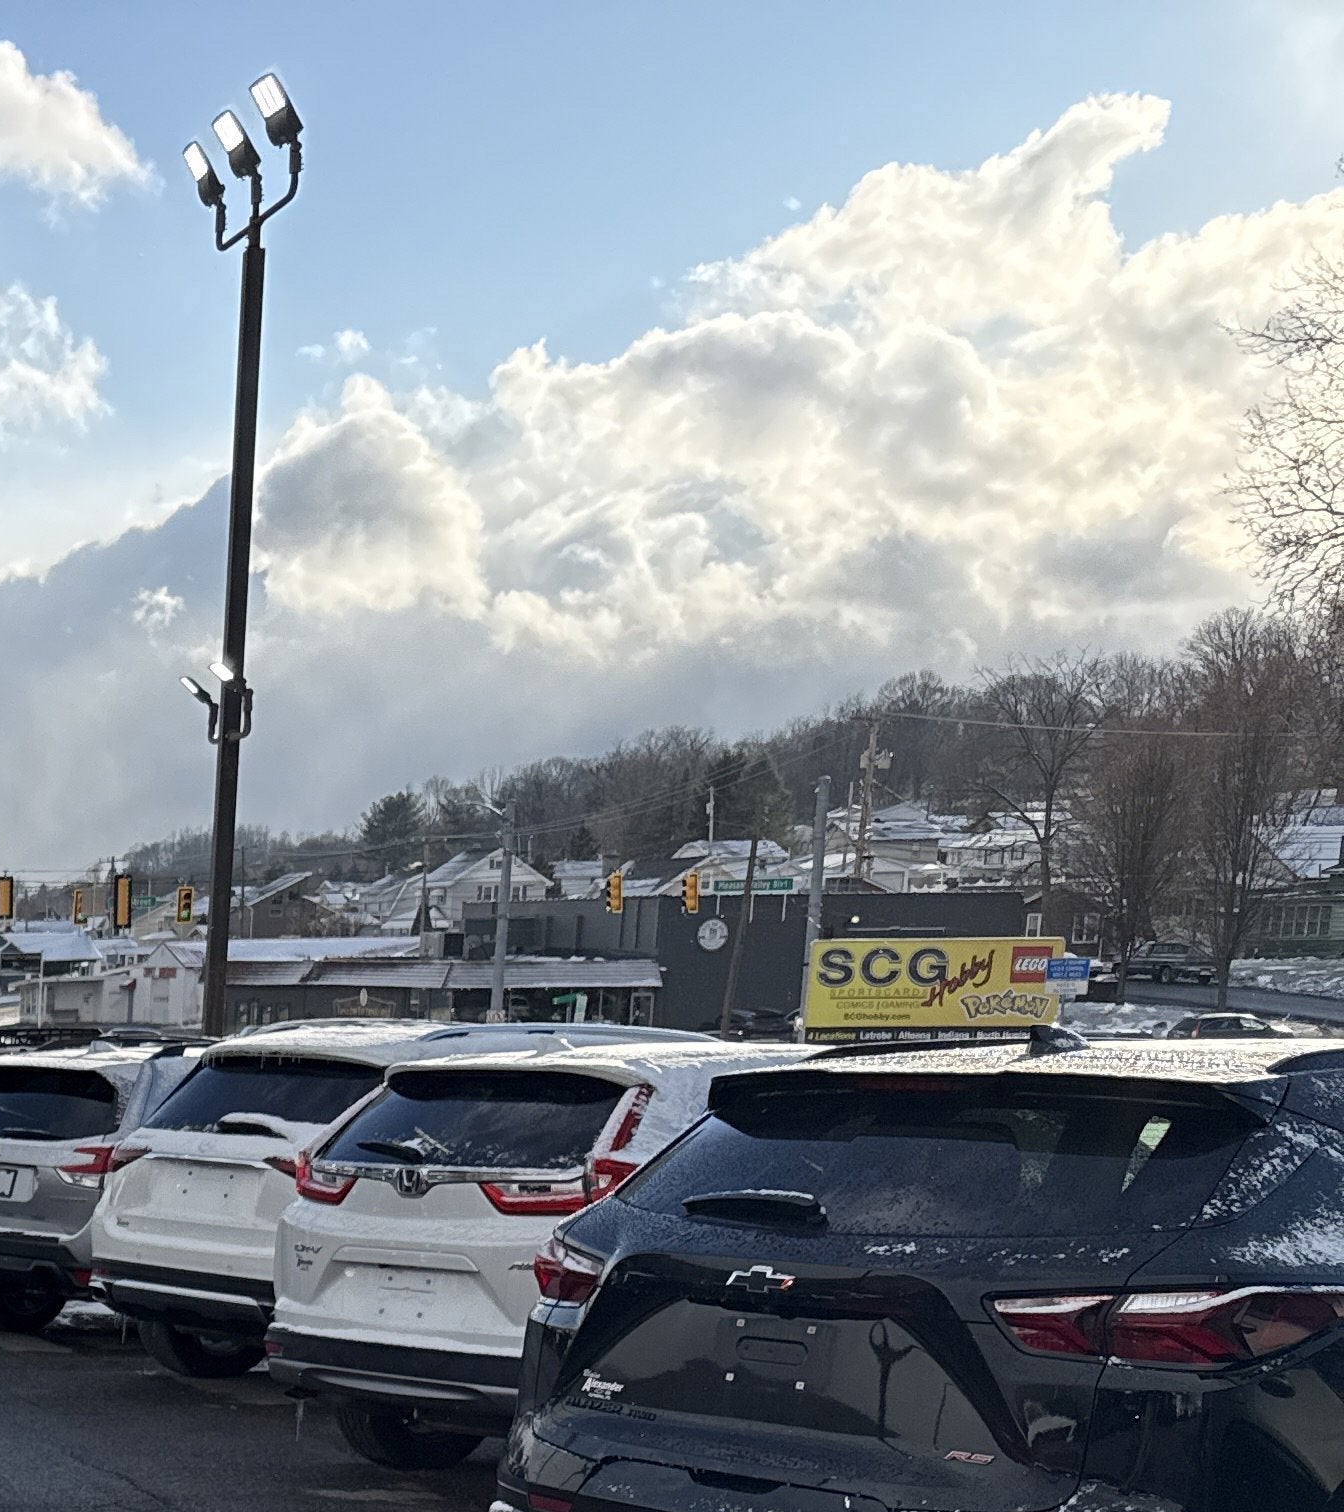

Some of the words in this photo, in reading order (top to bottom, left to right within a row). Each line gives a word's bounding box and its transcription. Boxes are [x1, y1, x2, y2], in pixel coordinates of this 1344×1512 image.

[1014, 958, 1048, 971] LEGO
[816, 946, 949, 988] SCG
[920, 949, 995, 1008] Hobby
[943, 1450, 995, 1465] RS
